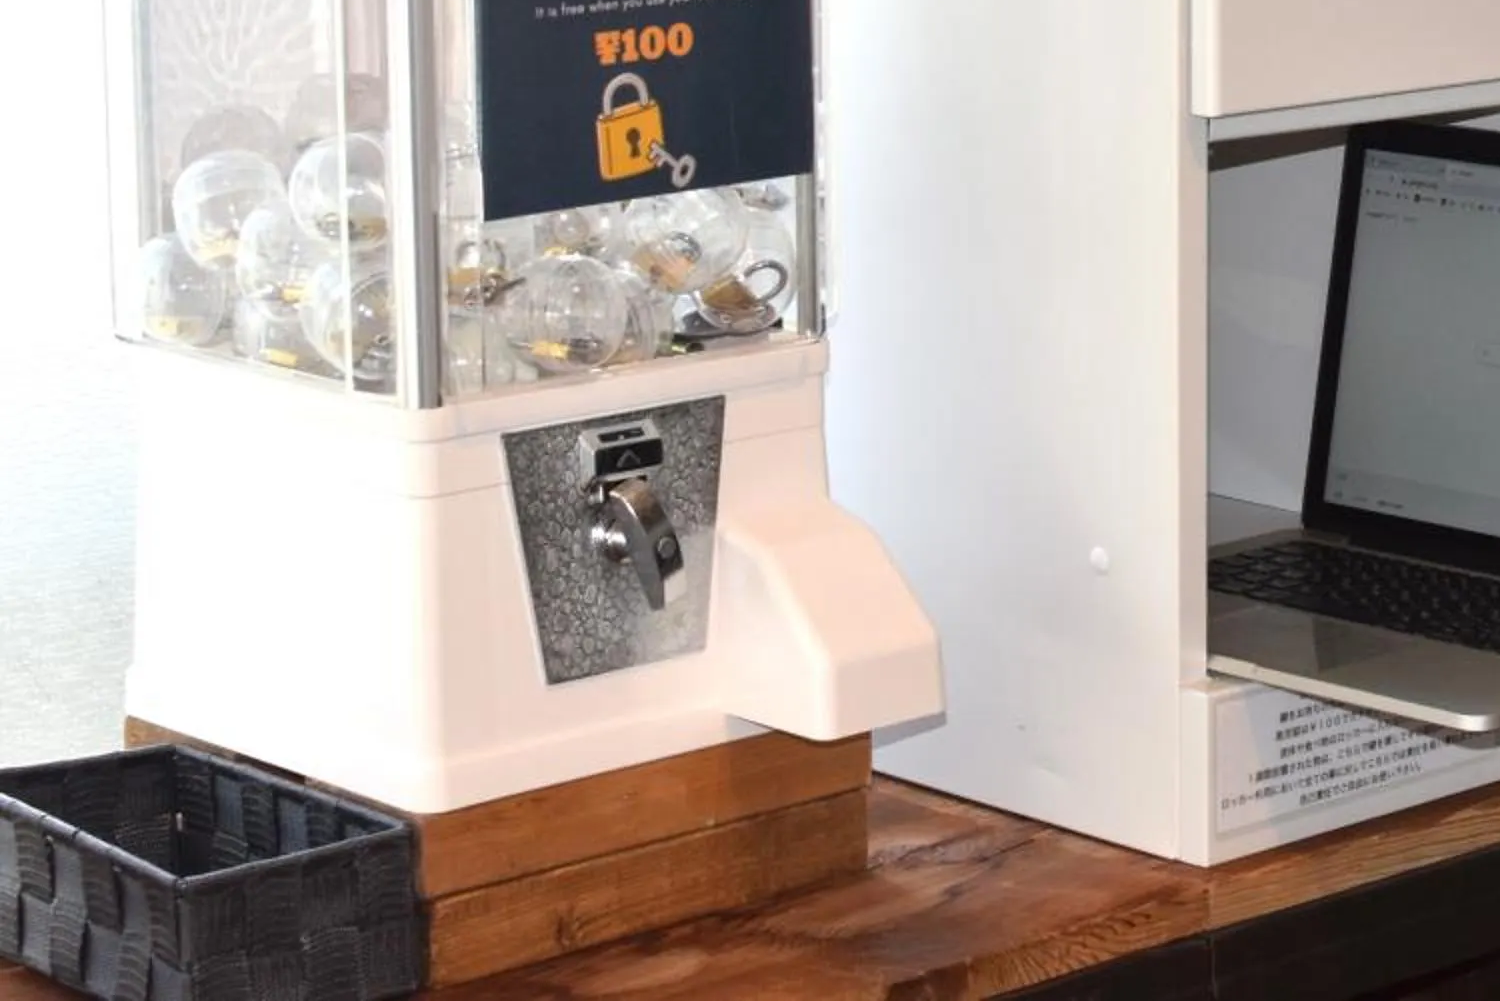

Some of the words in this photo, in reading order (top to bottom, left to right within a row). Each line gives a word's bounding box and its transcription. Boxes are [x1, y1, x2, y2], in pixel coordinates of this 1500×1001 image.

[535, 5, 545, 19] It
[547, 5, 559, 18] is
[561, 0, 585, 16] free
[589, 0, 619, 13] when
[594, 21, 695, 67] ¥100
